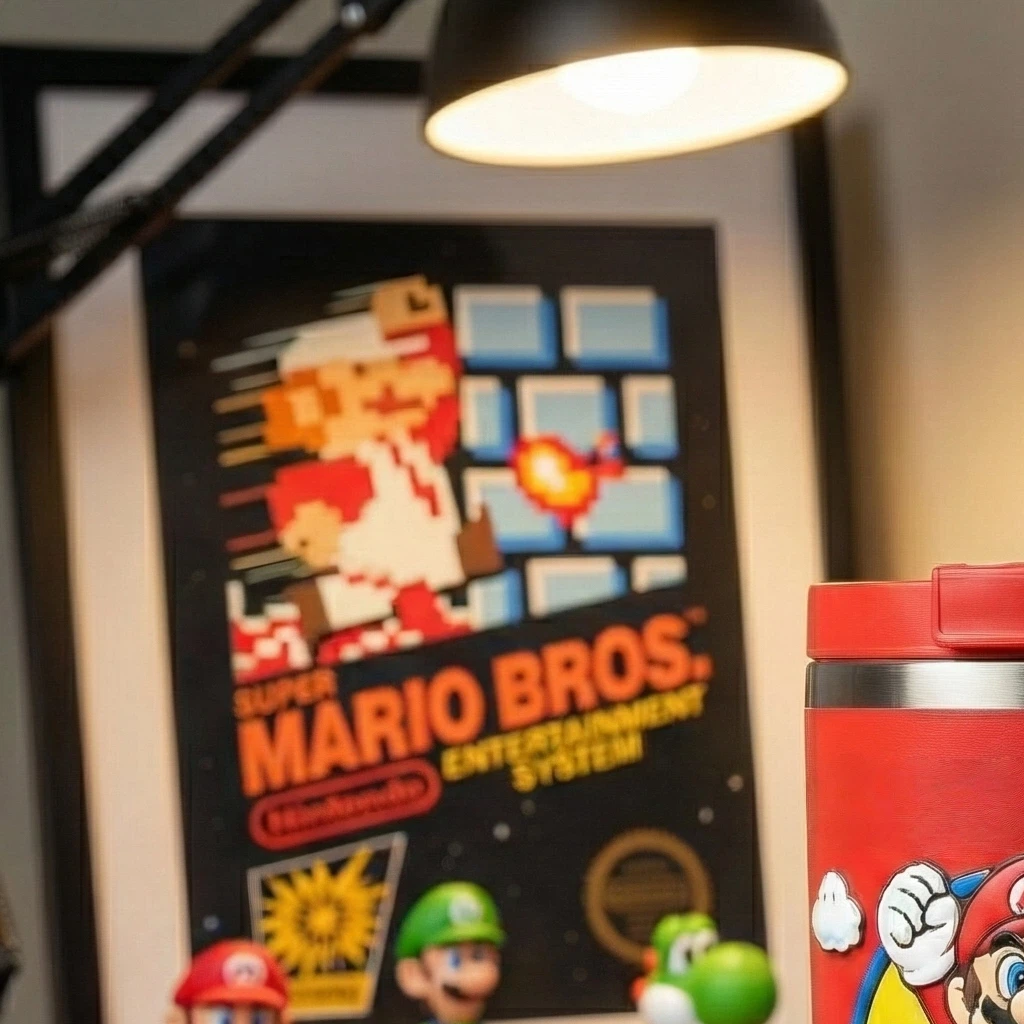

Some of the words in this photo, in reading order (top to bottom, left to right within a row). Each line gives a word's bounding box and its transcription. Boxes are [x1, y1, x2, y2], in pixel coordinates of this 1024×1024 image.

[233, 669, 337, 719] SUPER
[238, 666, 485, 797] MARIO
[492, 613, 713, 730] BROS.
[511, 730, 643, 793] SYSTEM
